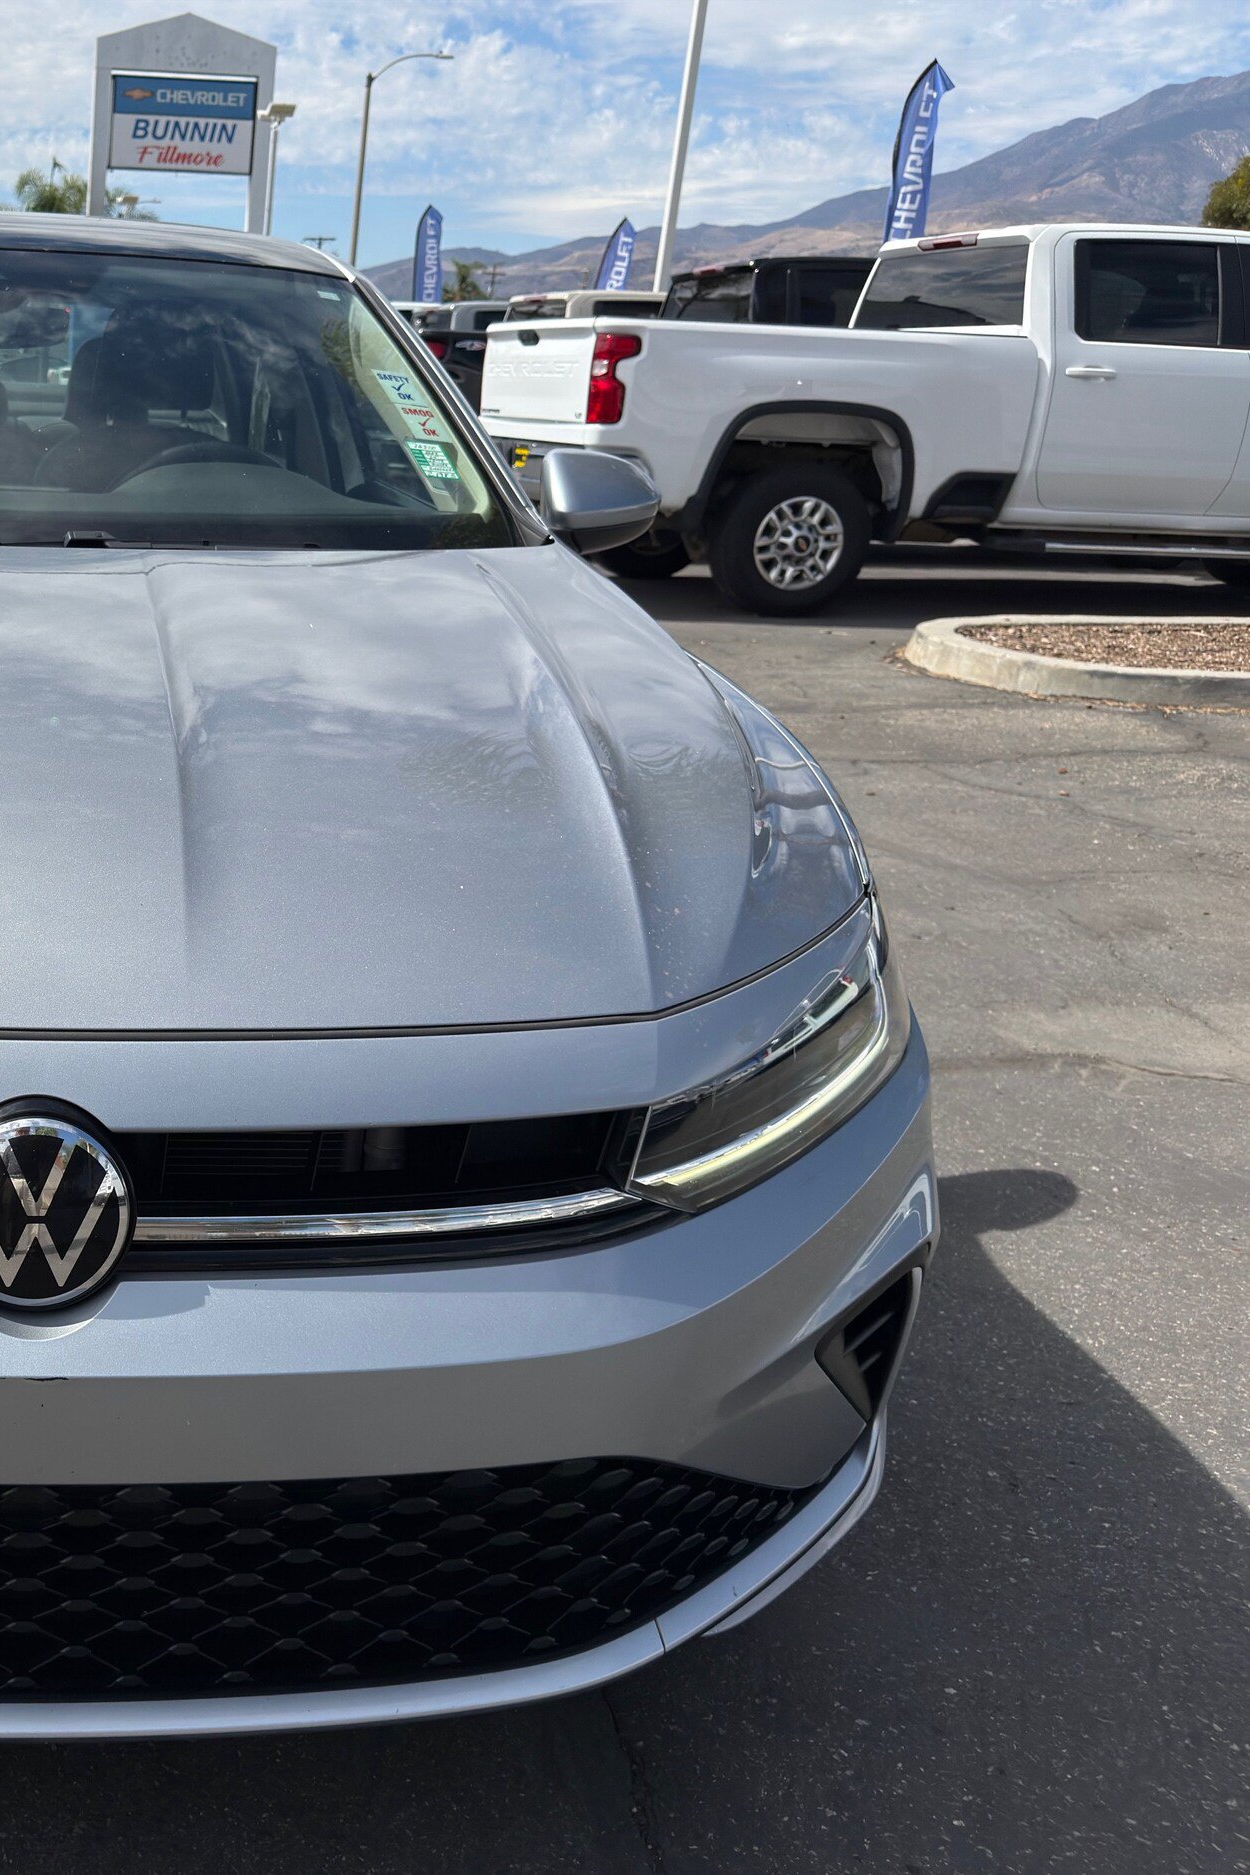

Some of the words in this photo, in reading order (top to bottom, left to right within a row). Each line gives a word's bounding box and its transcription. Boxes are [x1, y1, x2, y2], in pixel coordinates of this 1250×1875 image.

[156, 88, 247, 107] CHEVROLET
[132, 118, 237, 144] BUNNIN
[137, 145, 225, 168] Fillmore
[376, 372, 410, 384] SAFETY
[397, 392, 415, 401] OK
[401, 407, 435, 418] SMOG
[422, 427, 440, 437] OK
